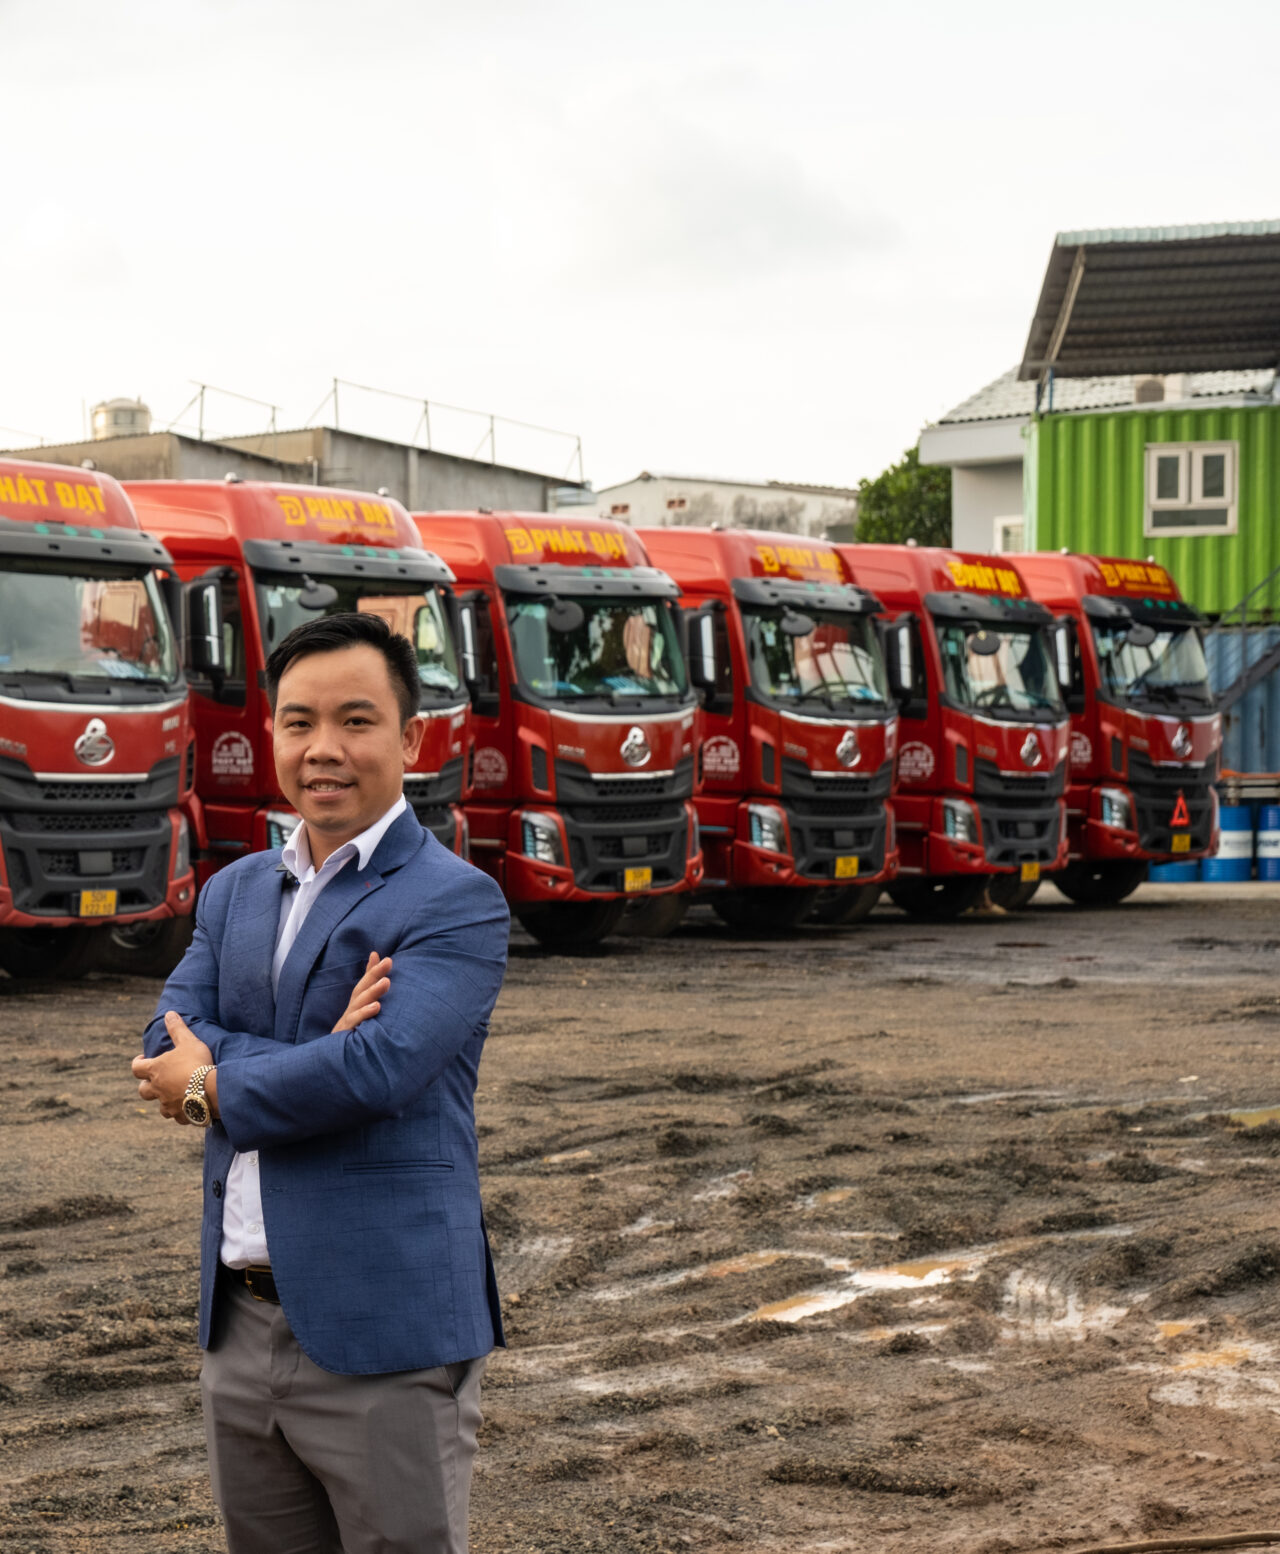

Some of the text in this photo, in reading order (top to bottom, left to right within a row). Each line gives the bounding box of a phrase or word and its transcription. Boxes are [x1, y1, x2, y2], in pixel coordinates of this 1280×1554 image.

[54, 481, 106, 515] ĐẠT
[303, 496, 357, 521] PHÁT
[530, 525, 587, 554] PHÁT
